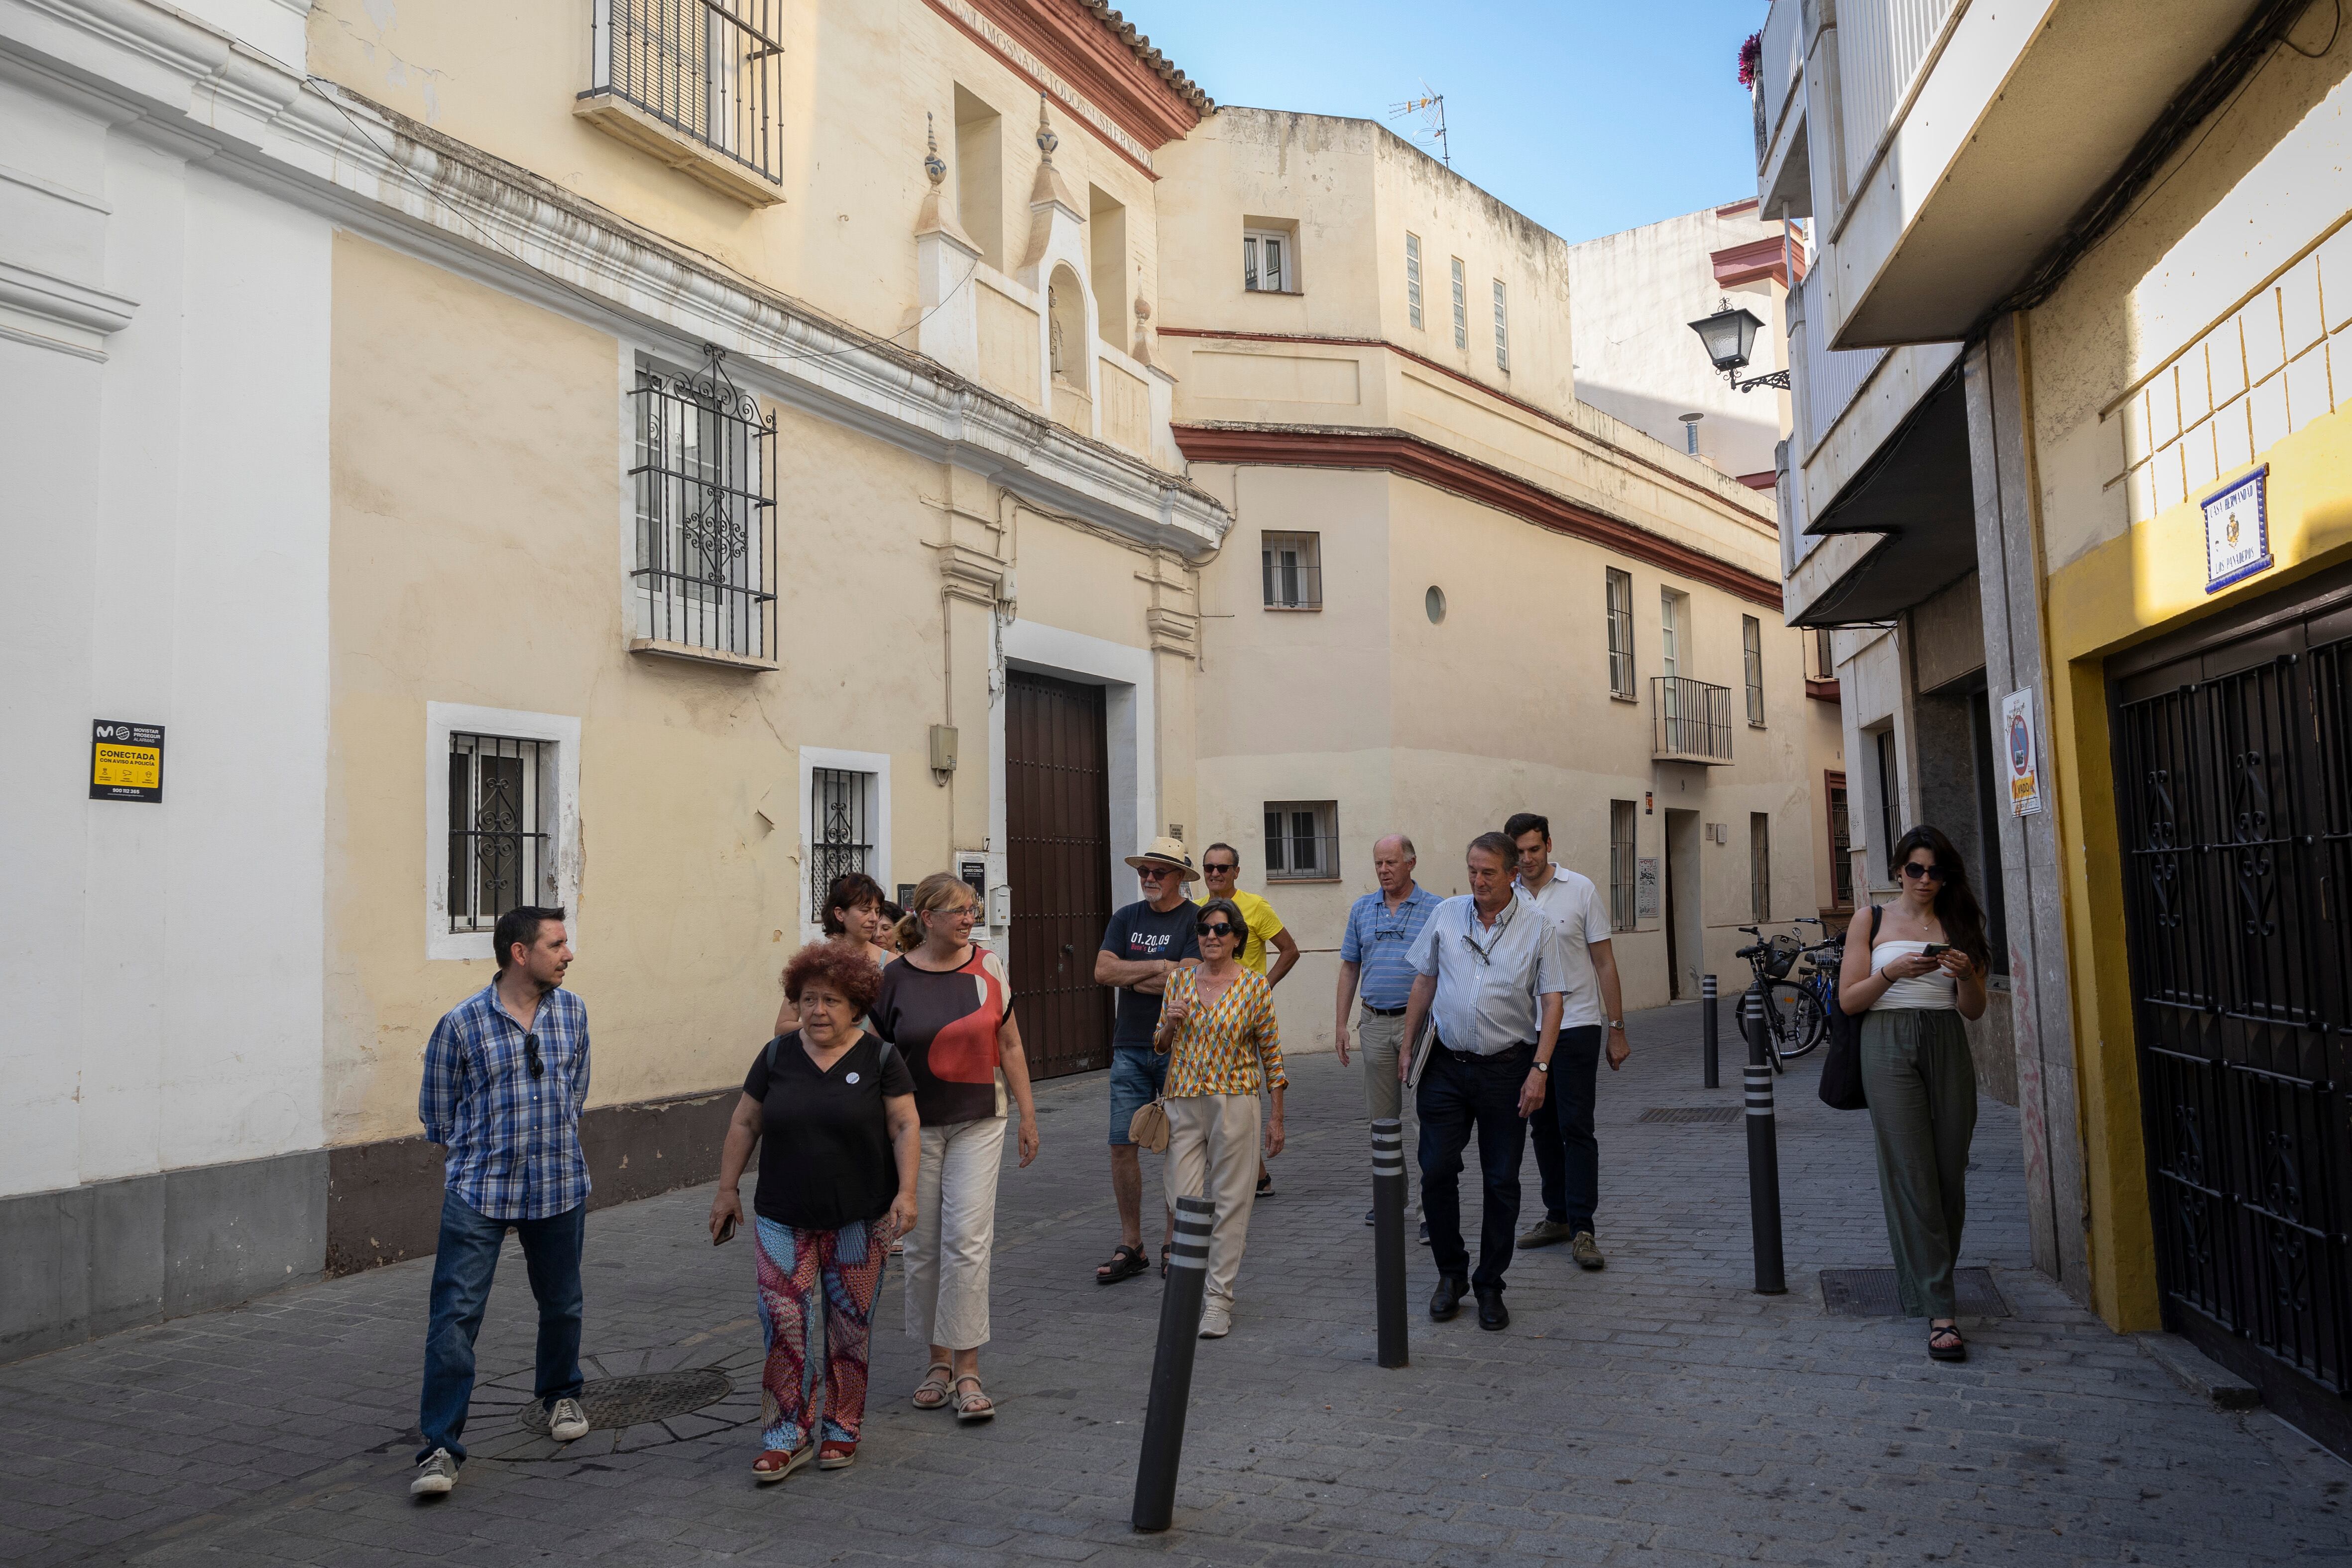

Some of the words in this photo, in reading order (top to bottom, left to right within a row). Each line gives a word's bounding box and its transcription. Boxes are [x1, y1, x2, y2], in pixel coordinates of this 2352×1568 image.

[2210, 502, 2223, 518] CASA
[2225, 484, 2253, 510] HERMANDAD
[2216, 560, 2225, 574] LOS
[2227, 546, 2254, 569] PANADEROS
[100, 750, 155, 761] CONECTADA
[2017, 783, 2029, 794] VADO
[985, 838, 990, 850] 7
[1131, 932, 1170, 946] 01.20.09
